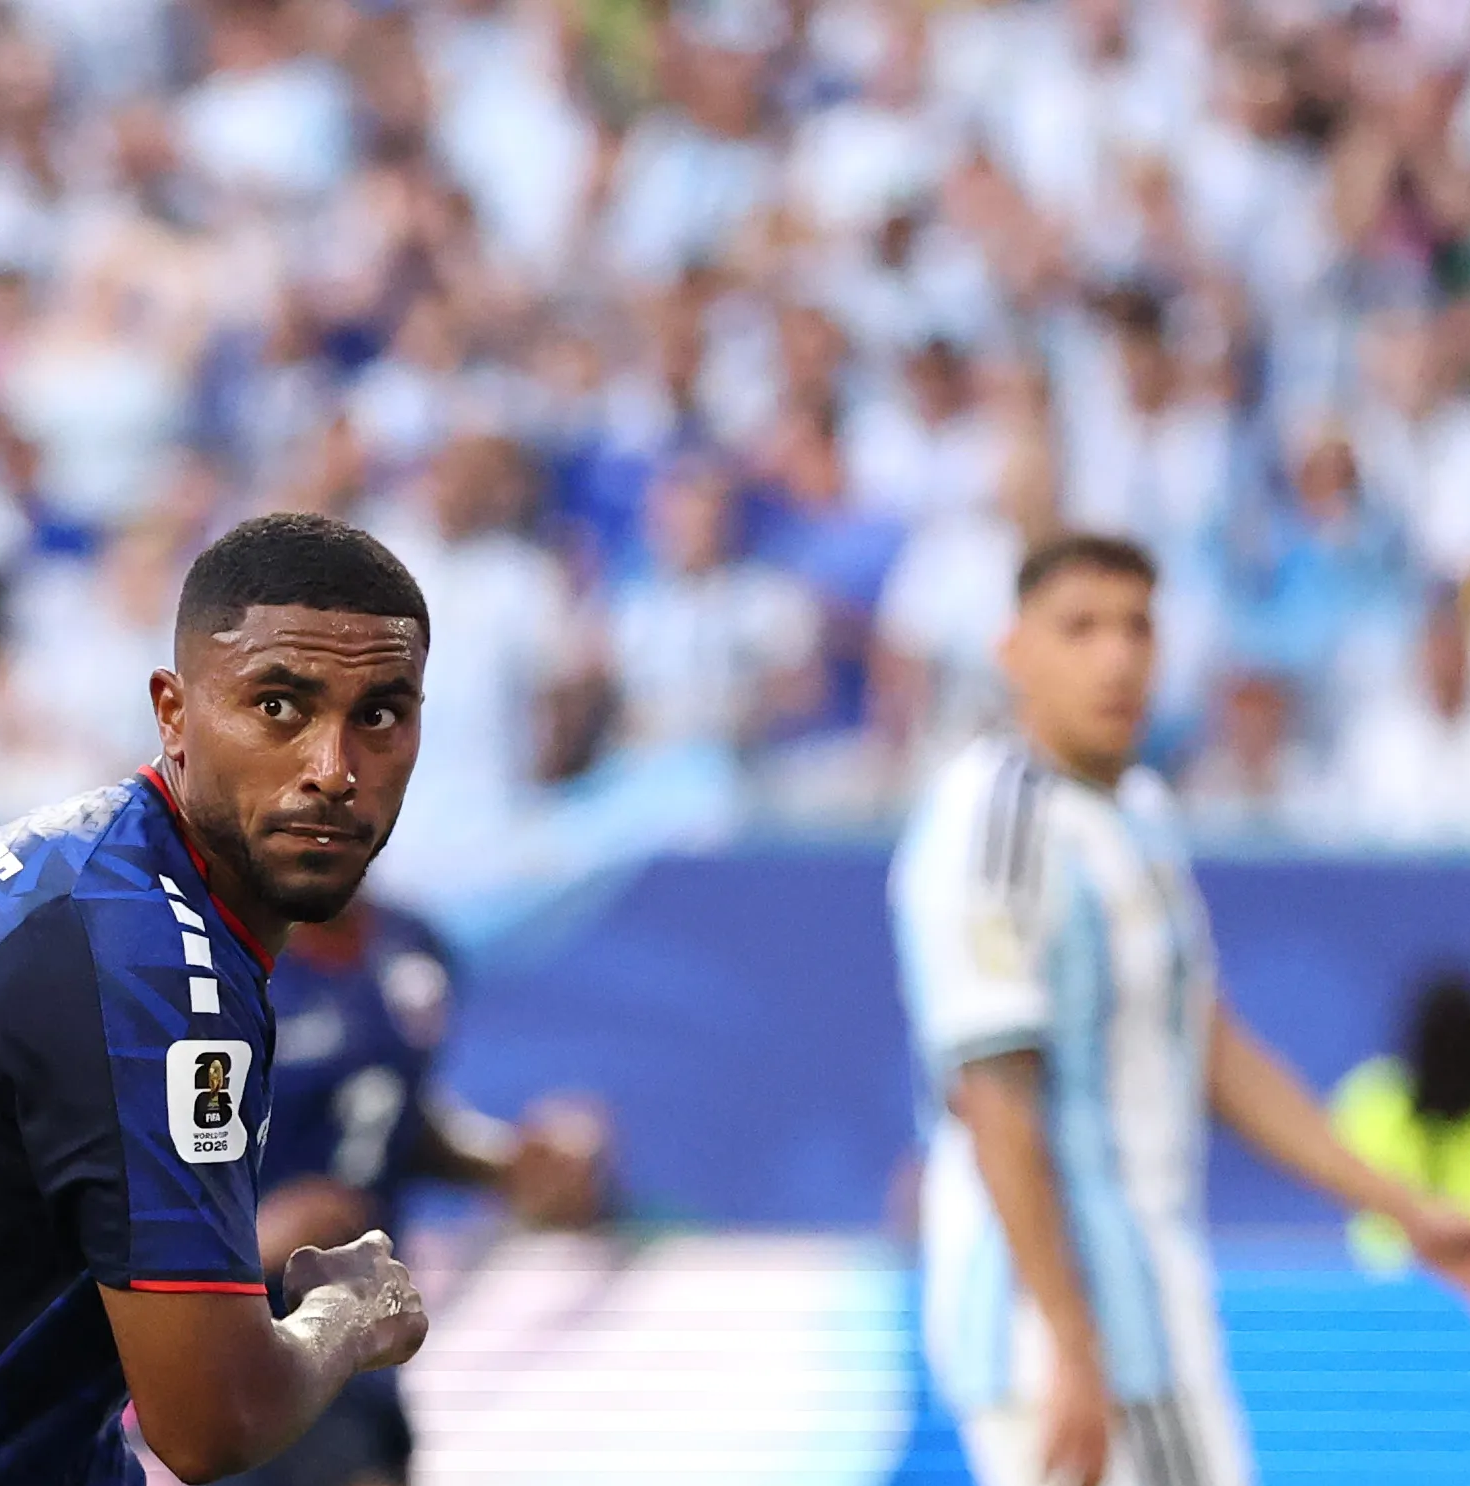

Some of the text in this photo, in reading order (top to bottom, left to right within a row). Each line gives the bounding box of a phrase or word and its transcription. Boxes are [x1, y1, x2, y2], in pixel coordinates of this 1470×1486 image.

[205, 1112, 221, 1123] FIFA
[193, 1131, 219, 1140] WORLD
[194, 1140, 228, 1153] 2026
